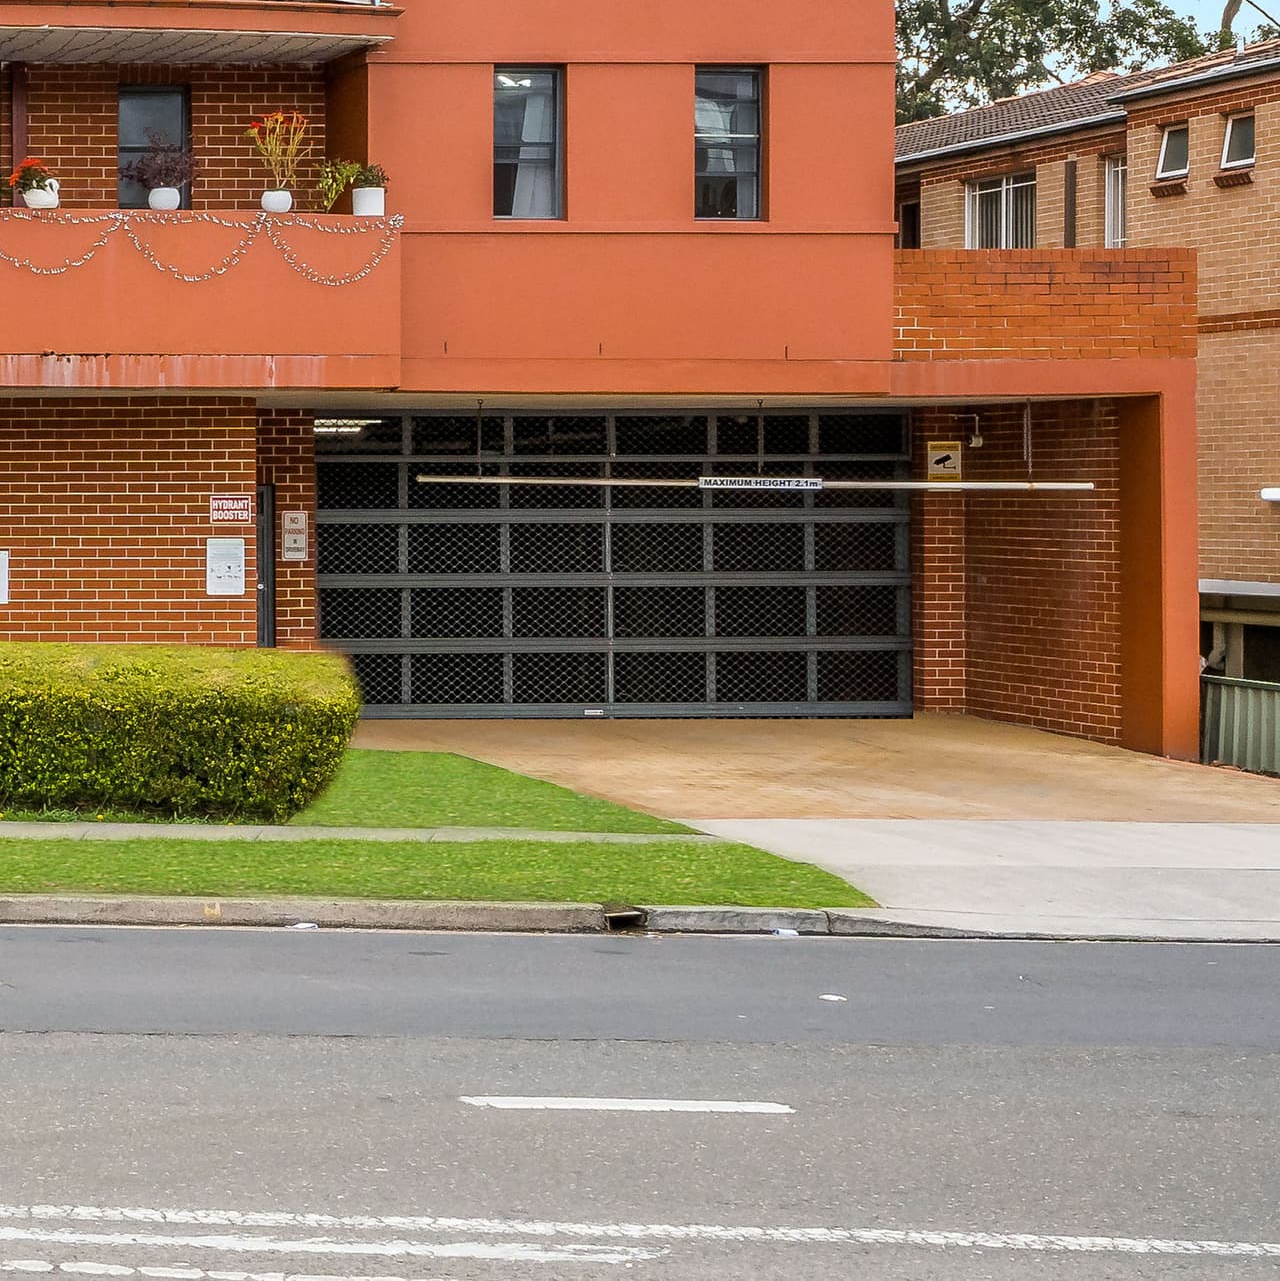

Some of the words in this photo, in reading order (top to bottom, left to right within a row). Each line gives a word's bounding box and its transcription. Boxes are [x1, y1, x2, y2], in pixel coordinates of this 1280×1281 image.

[703, 478, 754, 487] MAXIMUM
[755, 479, 793, 488] HEIGHT
[794, 479, 819, 488] 2.1m
[212, 499, 249, 510] HYDRANT
[213, 510, 249, 520] BOOSTER
[289, 516, 299, 525] NO
